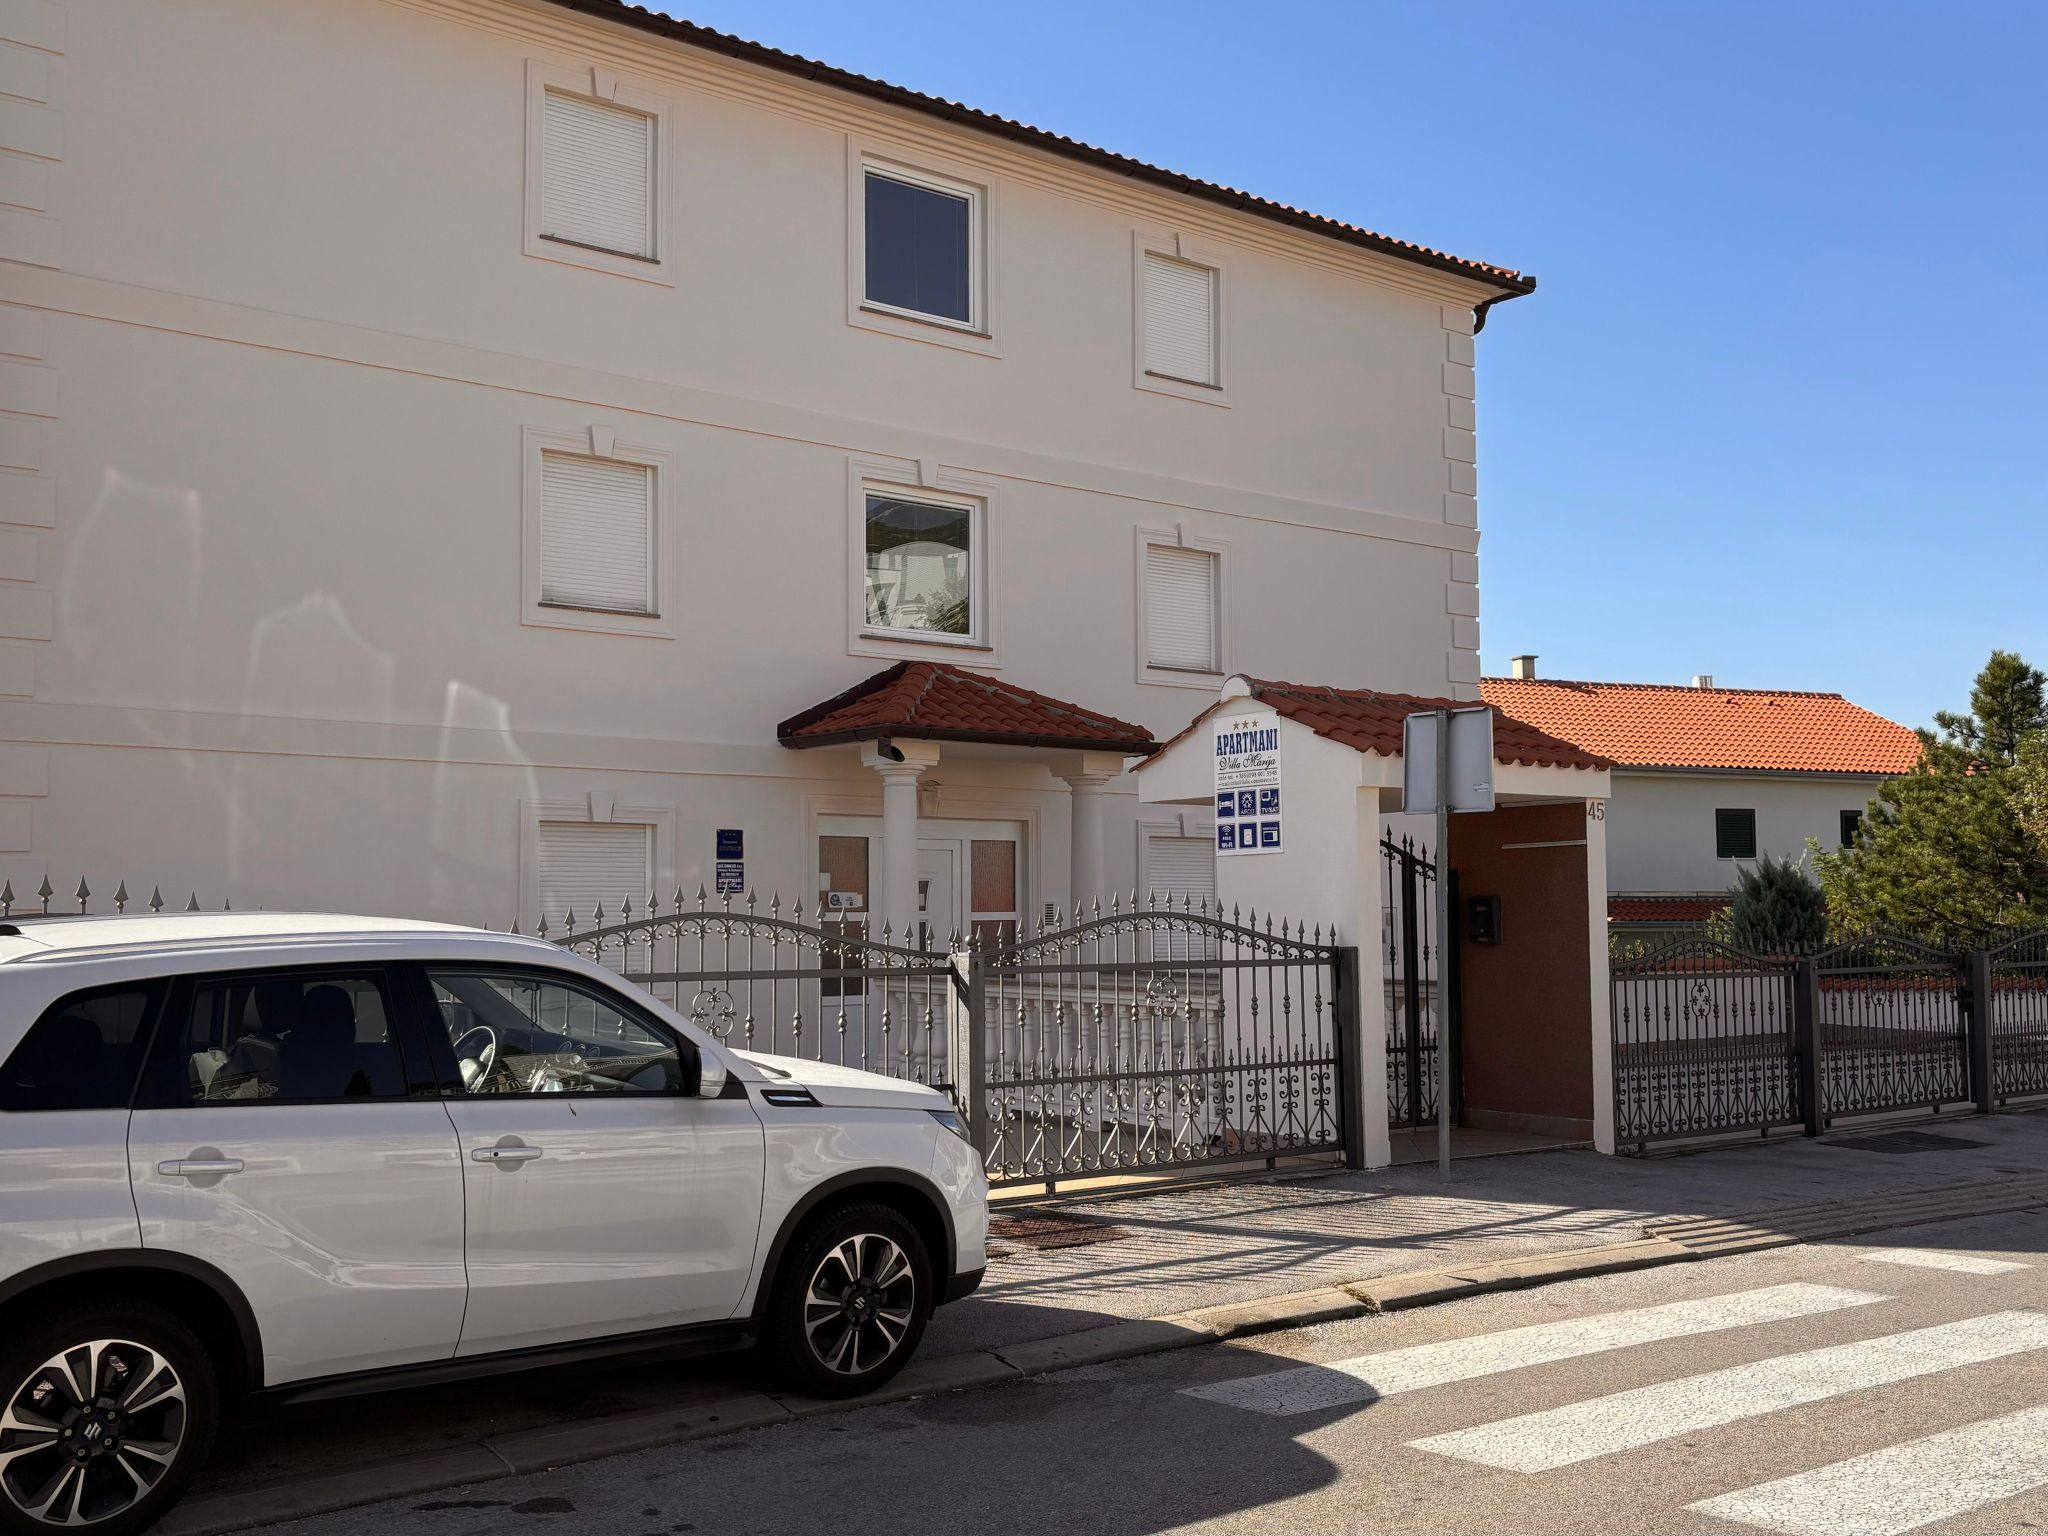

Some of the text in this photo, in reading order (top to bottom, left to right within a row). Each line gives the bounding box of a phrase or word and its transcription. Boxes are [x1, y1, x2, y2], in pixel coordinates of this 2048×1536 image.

[1216, 728, 1278, 757] APARTMANI
[1219, 753, 1276, 771] Villa Marija
[1588, 801, 1605, 821] 45
